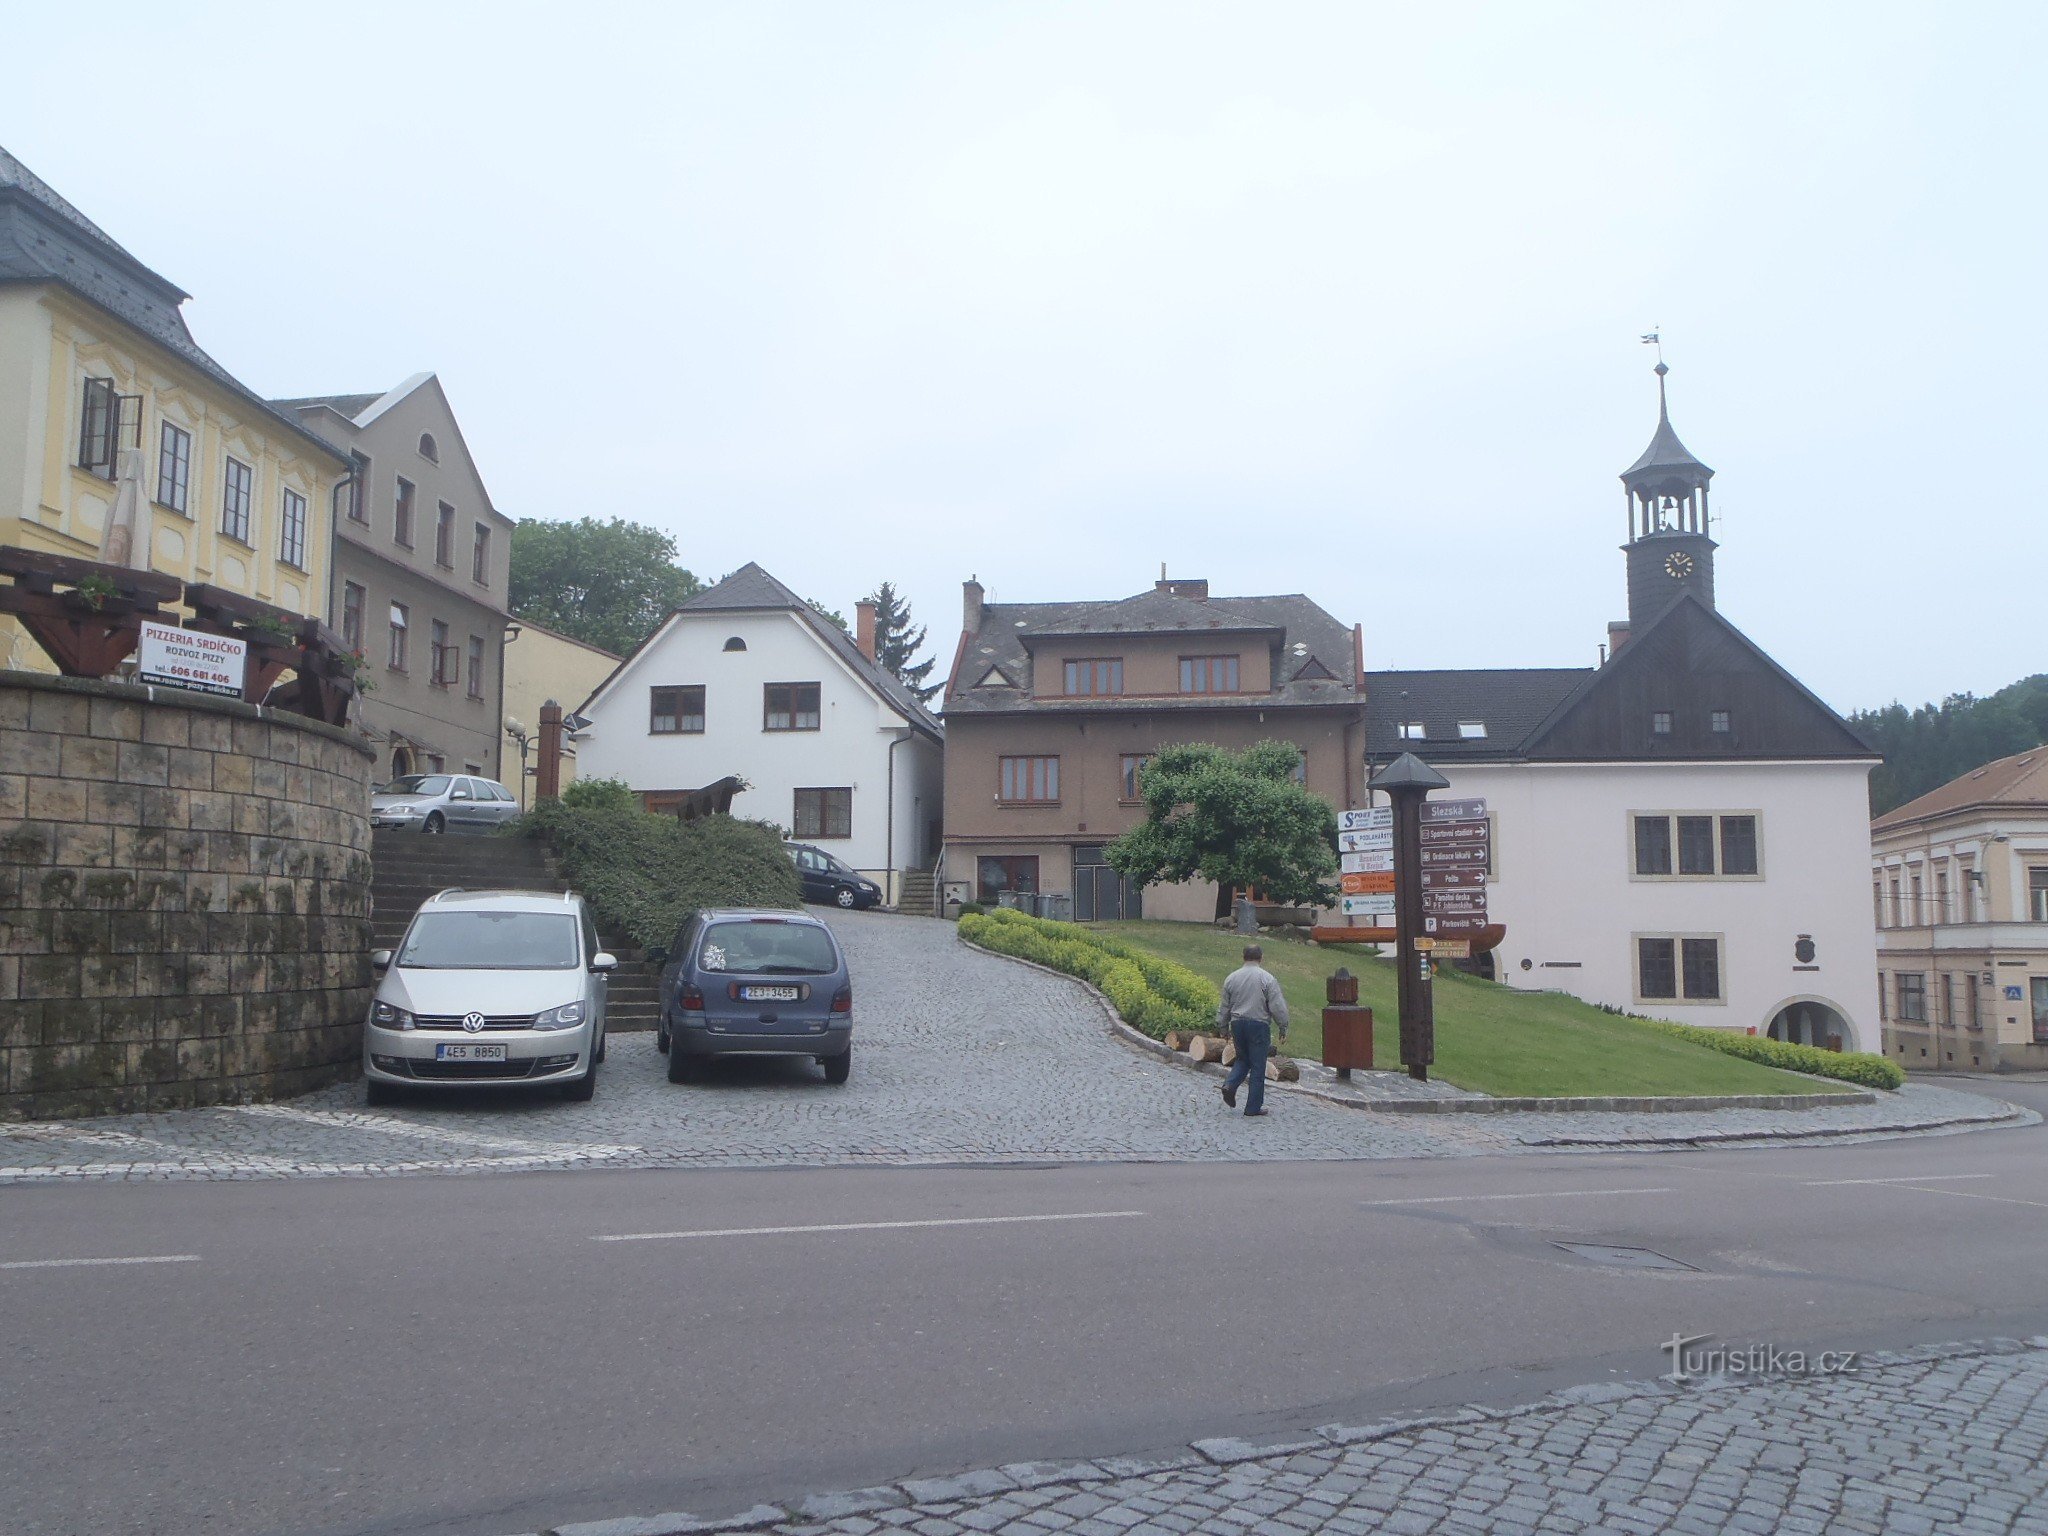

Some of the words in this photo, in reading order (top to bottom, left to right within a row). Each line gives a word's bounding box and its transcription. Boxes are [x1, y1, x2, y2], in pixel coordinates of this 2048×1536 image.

[146, 628, 193, 646] PIZZERIA
[196, 638, 241, 655] SRDÍČKO
[165, 645, 200, 659] ROZVOZ
[202, 652, 225, 664] PIZZY
[171, 666, 189, 676] 606
[192, 670, 208, 679] 681
[211, 673, 229, 684] 406
[1431, 805, 1463, 817] Slezská
[1344, 811, 1370, 828] SPORT
[1360, 832, 1392, 841] PODLAHÁŘSTV
[1444, 874, 1459, 882] Pošta
[1428, 920, 1434, 929] P
[748, 987, 765, 997] 2E3
[771, 988, 794, 997] 3455
[446, 1047, 466, 1058] 4E5
[474, 1047, 501, 1058] 8850
